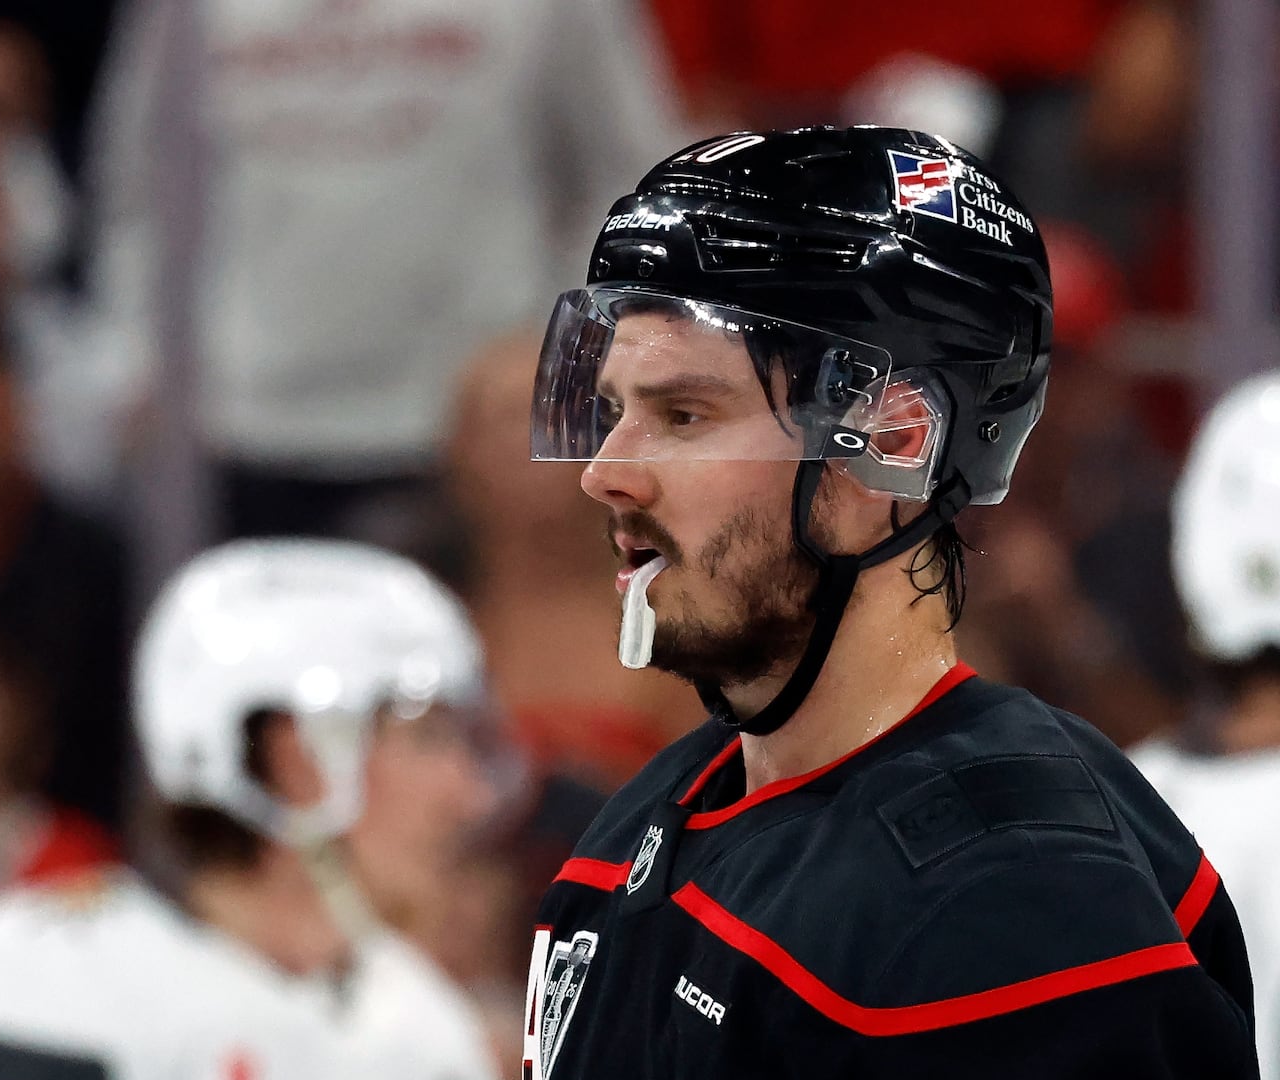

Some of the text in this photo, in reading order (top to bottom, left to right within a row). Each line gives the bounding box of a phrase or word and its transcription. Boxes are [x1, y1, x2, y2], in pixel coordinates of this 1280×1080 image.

[958, 183, 1034, 234] Citizens
[961, 206, 1014, 247] Bank
[674, 974, 727, 1026] UCOR
